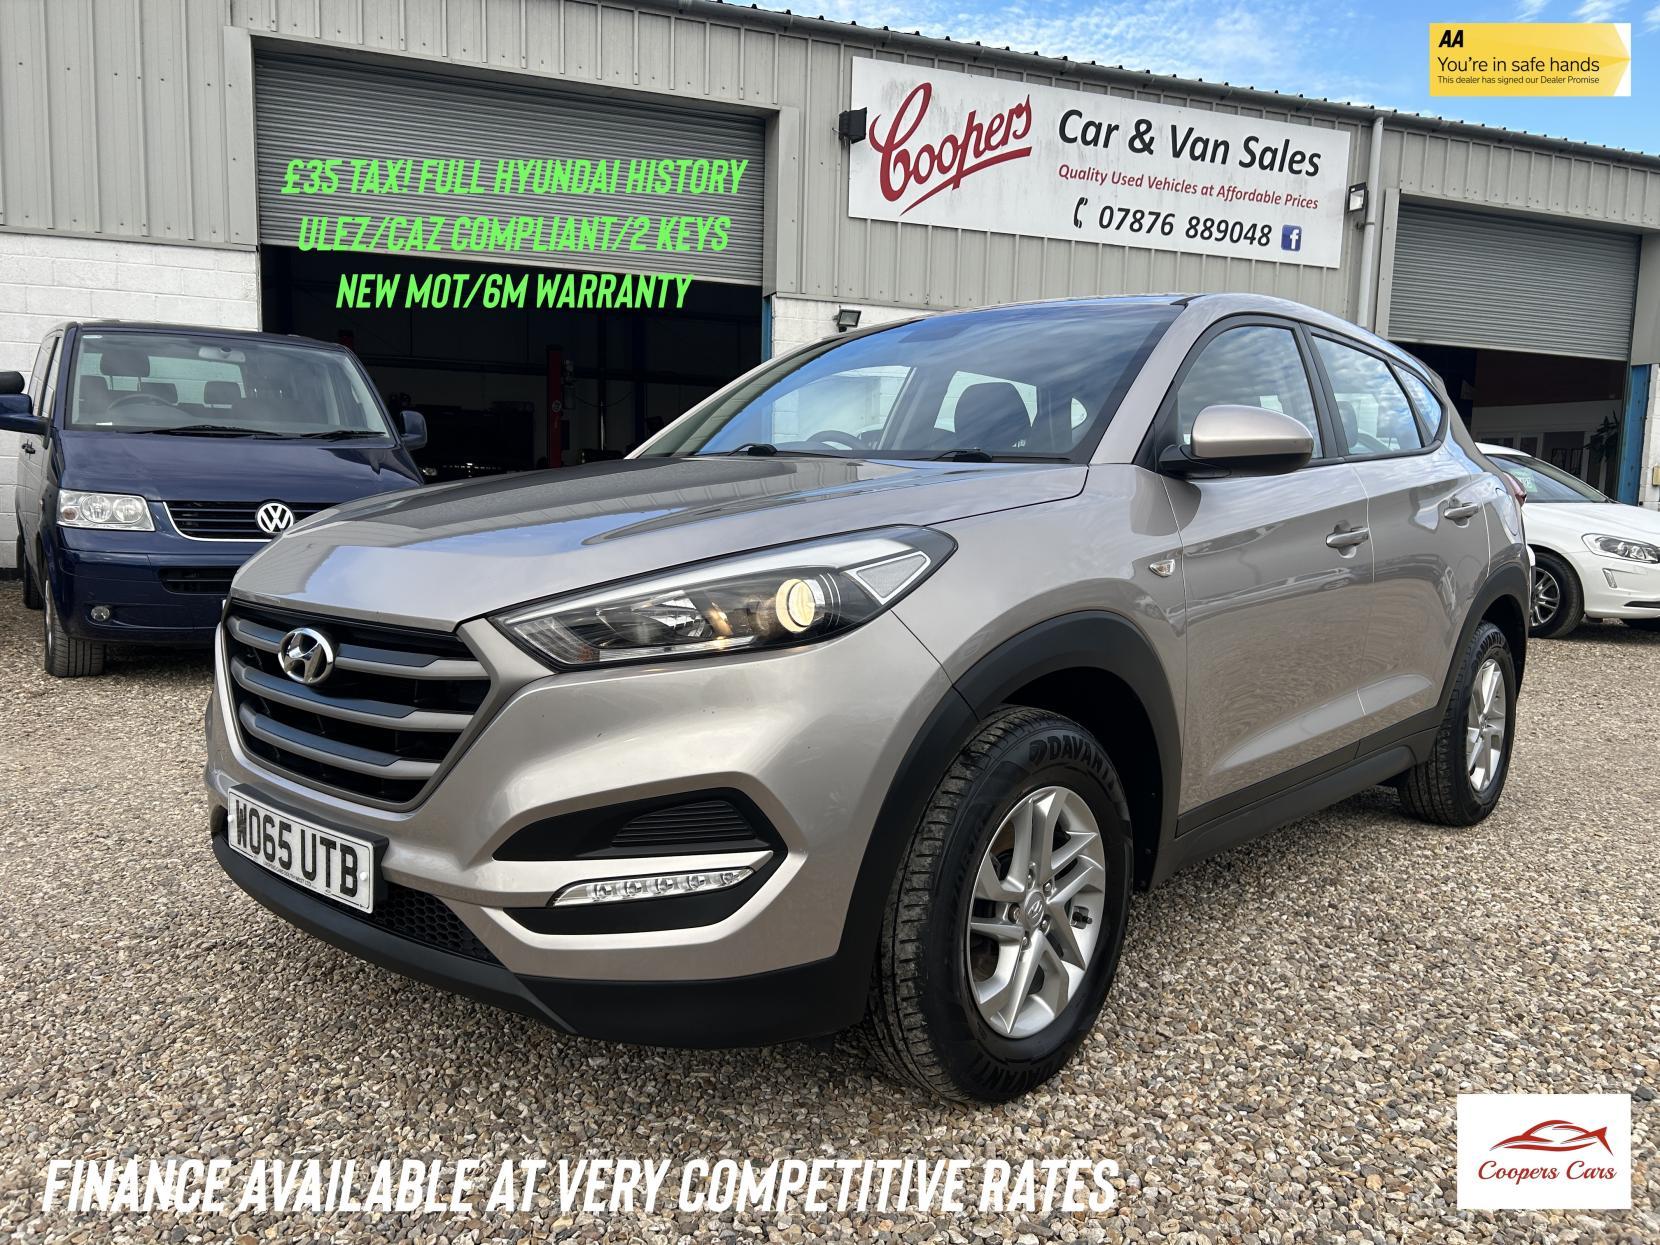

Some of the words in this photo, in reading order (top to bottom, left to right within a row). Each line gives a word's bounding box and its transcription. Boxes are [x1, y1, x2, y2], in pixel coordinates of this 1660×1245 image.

[869, 82, 1033, 202] Coopers
[1058, 109, 1119, 149] Car
[1128, 119, 1155, 156] &
[1170, 124, 1230, 165] Van
[1239, 136, 1322, 177] Sales
[1058, 164, 1108, 186] Quality
[1111, 171, 1145, 188] Used
[1148, 175, 1198, 195] Vehicles
[1200, 184, 1215, 197] at
[1216, 185, 1282, 205] Affordable
[1284, 193, 1319, 210] Prices
[1098, 205, 1176, 236] 07876
[1185, 216, 1273, 247] 889048
[300, 829, 358, 898] UTB
